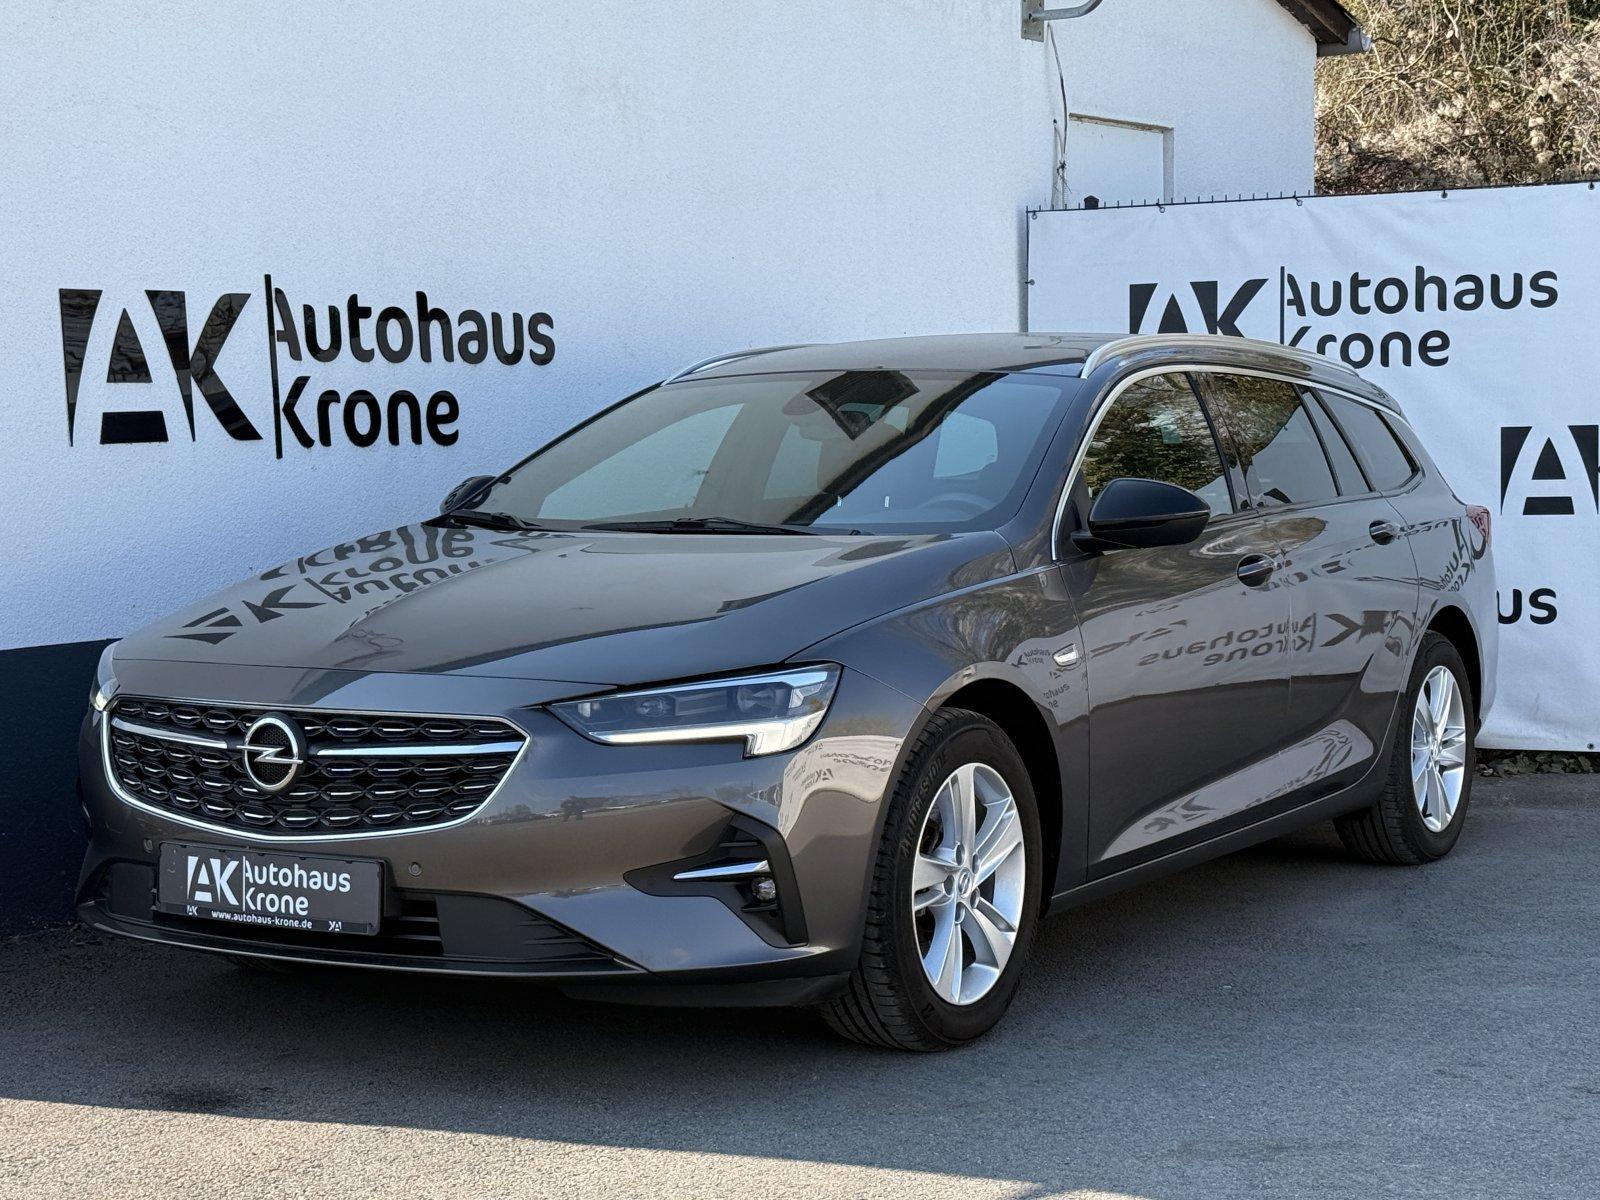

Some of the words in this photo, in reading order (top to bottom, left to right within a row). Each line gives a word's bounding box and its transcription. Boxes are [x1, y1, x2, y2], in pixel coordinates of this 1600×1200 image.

[1286, 265, 1559, 318] Autohaus
[274, 286, 556, 367] Autohaus
[281, 375, 460, 448] Krone
[186, 855, 240, 906] AK
[245, 859, 351, 893] Autohaus
[245, 887, 309, 916] Krone
[211, 910, 313, 929] www.autohaus-krone.de
